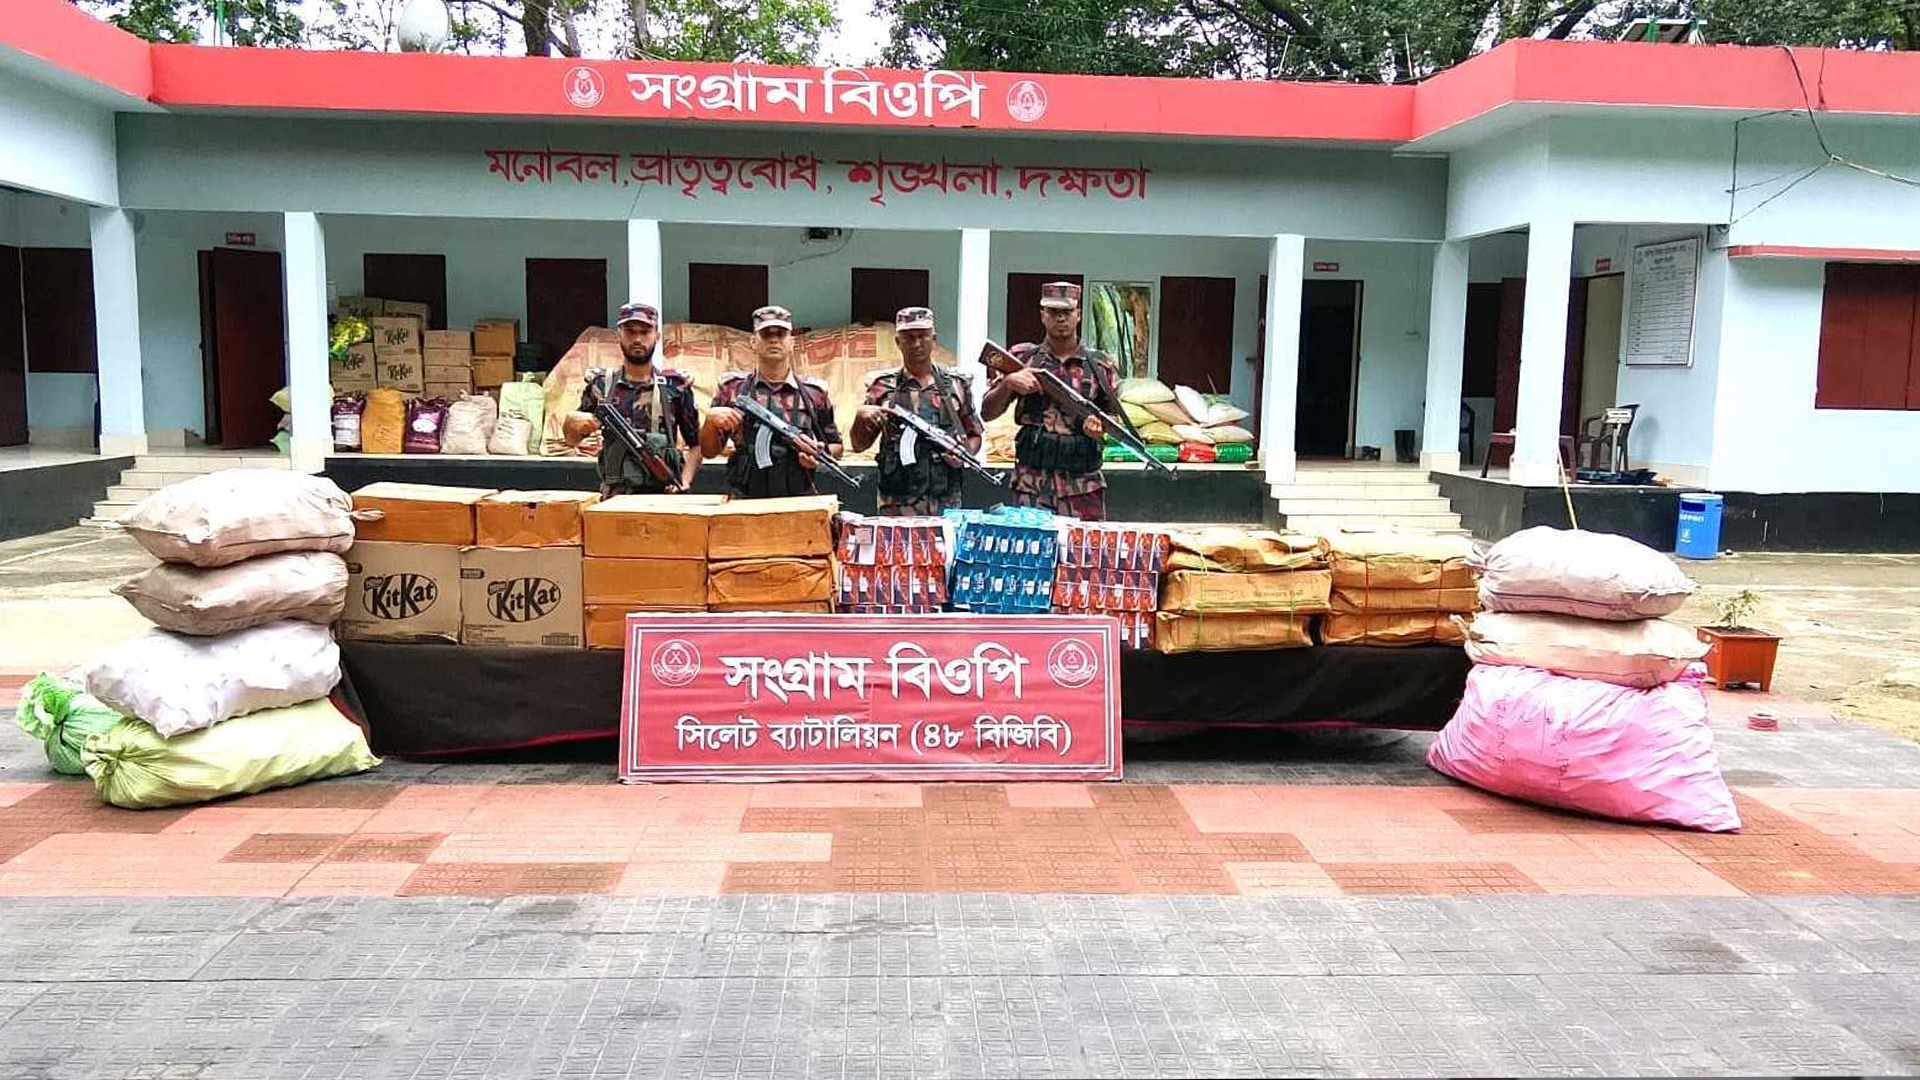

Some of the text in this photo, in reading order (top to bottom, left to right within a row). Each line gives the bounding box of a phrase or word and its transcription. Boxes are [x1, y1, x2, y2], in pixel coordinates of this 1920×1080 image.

[626, 67, 988, 119] সংগ্রাম বিওপি
[1013, 157, 1152, 200] দক্ষতা
[370, 574, 435, 619] KitKat
[496, 578, 558, 622] KitKat
[719, 641, 1030, 703] সংগ্রাম বিওপি
[674, 714, 1073, 756] সিলেট ব্যাটালিয়ন (৪৮ বিজিবি)
